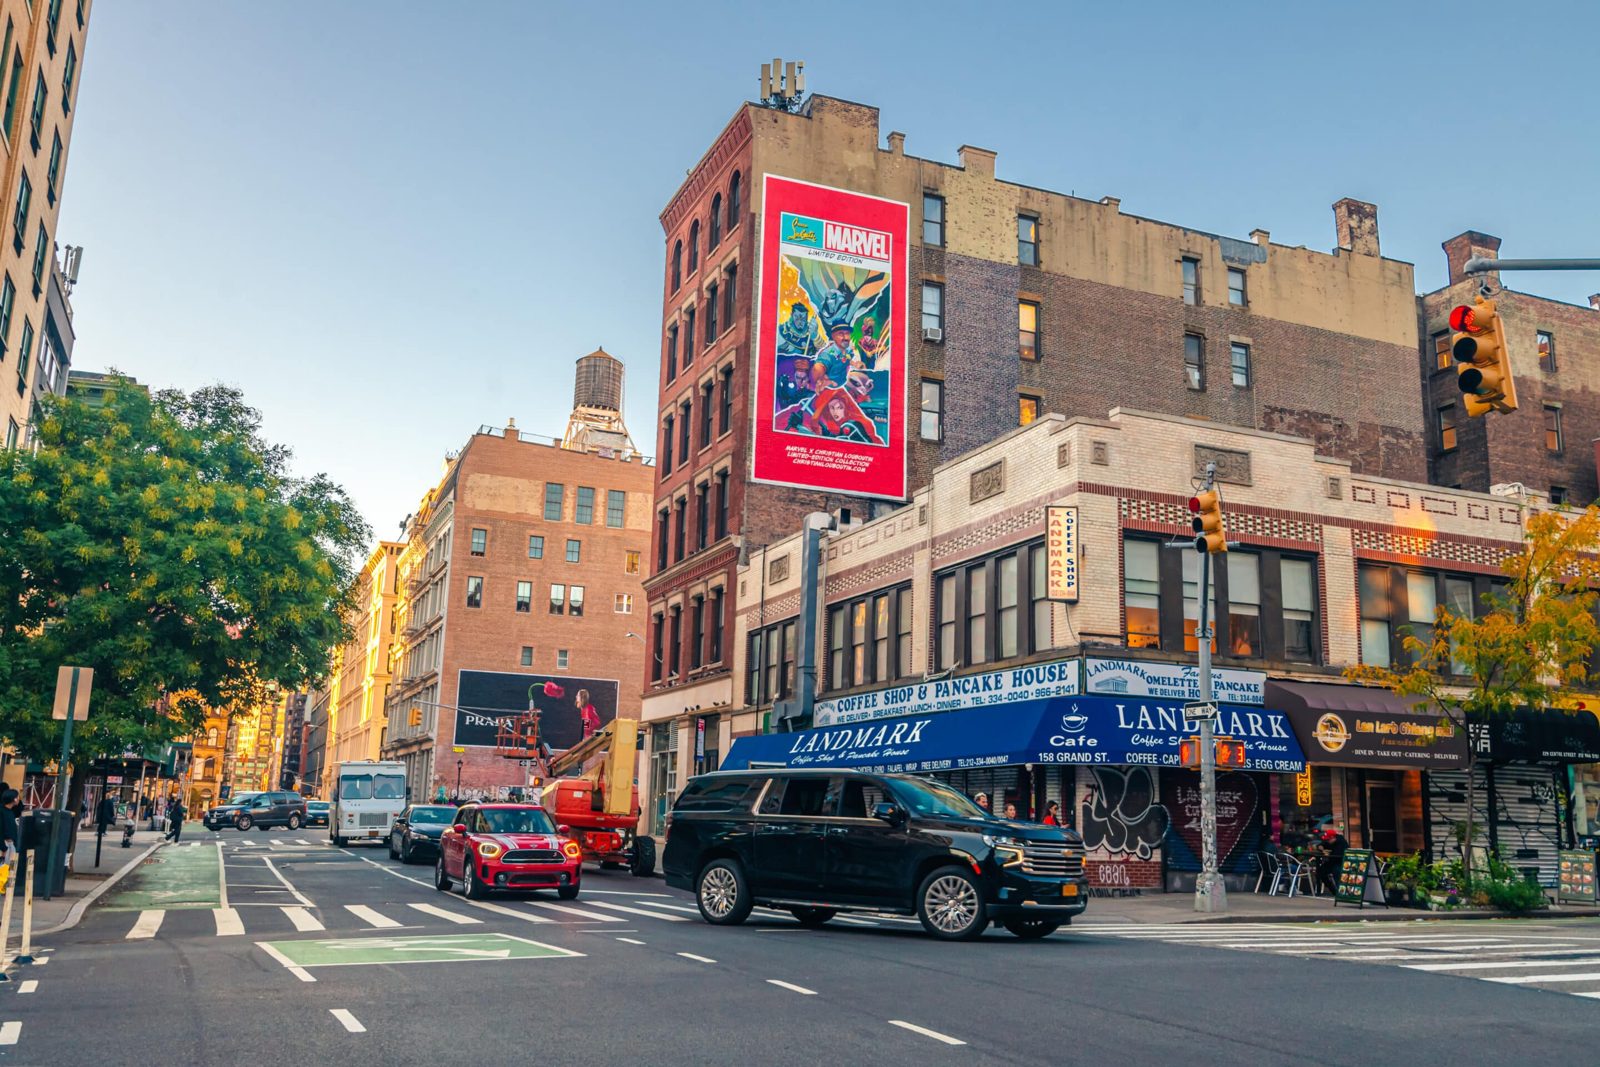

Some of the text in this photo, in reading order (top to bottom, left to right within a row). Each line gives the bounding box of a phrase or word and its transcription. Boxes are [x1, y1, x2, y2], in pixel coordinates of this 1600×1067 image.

[827, 224, 888, 260] MARVEL
[808, 250, 863, 264] LIMITED EDITION
[815, 449, 842, 458] CHRISTIAN
[844, 453, 873, 462] LOUBOUTIN
[835, 458, 870, 467] COLLECTION
[1050, 510, 1062, 587] LANDMARK
[1066, 558, 1074, 587] SHOP
[1087, 661, 1147, 680] LANDMARK
[1181, 665, 1222, 679] Faus
[837, 663, 1068, 712] COFFEE SHOP & PANCAKE HOUSE
[1146, 676, 1259, 693] OMELETTE PANCAKE
[1160, 689, 1185, 697] DELIVER
[873, 706, 906, 718] BREAKFAST
[911, 703, 932, 713] LUNCH
[937, 700, 961, 710] DINNER
[971, 697, 986, 705] TEL:
[988, 690, 1029, 702] 334-0040
[1035, 684, 1075, 697] 966-2141
[789, 720, 932, 753] LANDMARK
[1050, 735, 1098, 746] Cafe
[1131, 734, 1164, 747] Coffee
[1255, 741, 1288, 752] House
[791, 755, 814, 765] Coffee
[815, 753, 835, 762] Shop
[846, 750, 880, 760] Pancake
[882, 748, 910, 757] House
[921, 761, 931, 770] FREE
[932, 760, 951, 769] DELIVERY
[1039, 752, 1110, 762] 158 GRAND ST.
[1126, 753, 1157, 763] COFFEE
[1256, 759, 1273, 769] EGG
[1274, 760, 1302, 770] CREAM
